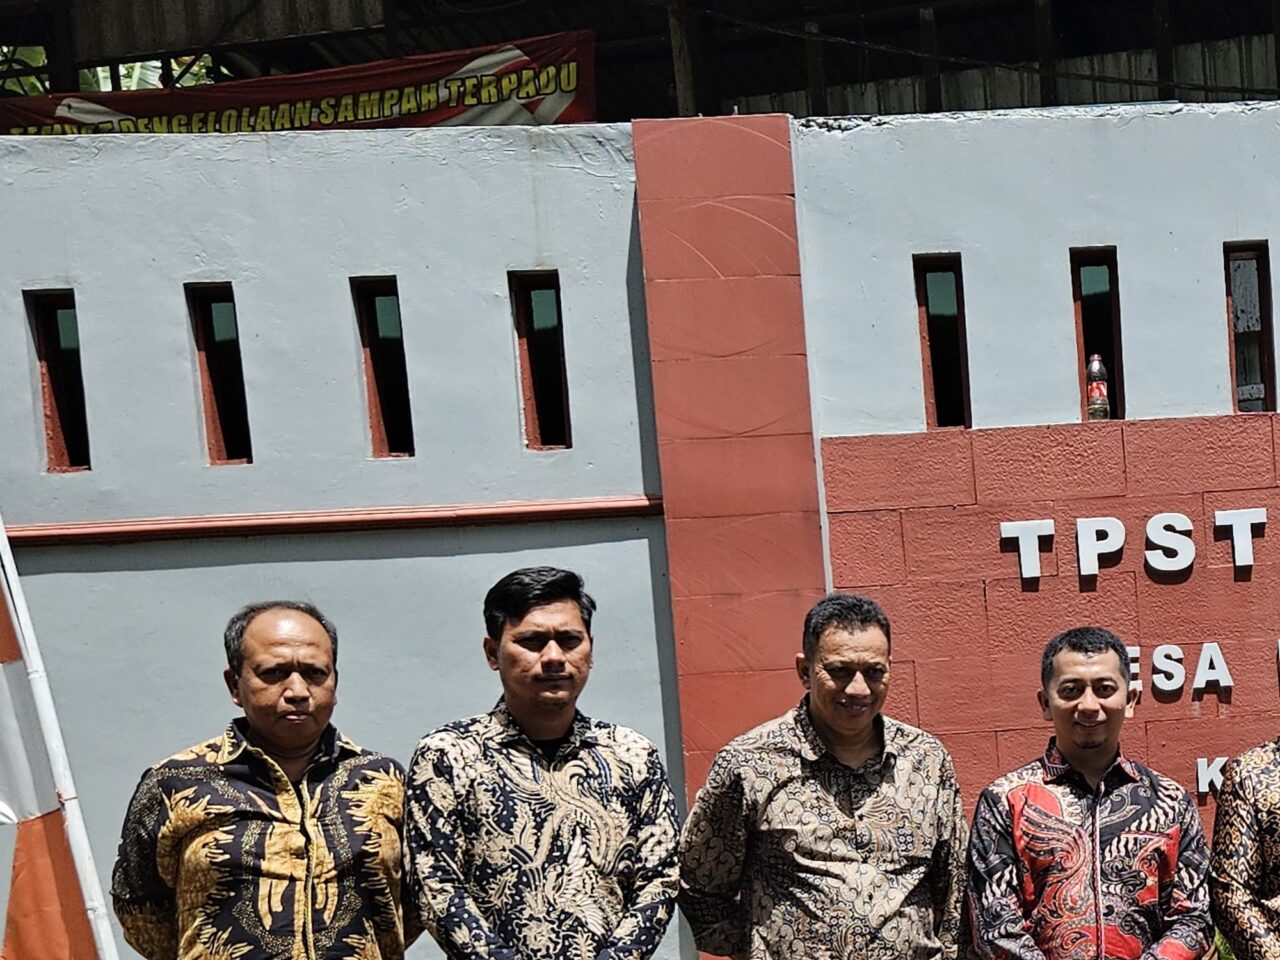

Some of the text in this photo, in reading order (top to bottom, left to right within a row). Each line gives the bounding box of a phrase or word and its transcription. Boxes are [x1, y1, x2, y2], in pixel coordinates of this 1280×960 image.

[319, 82, 438, 124] SAMPAH
[448, 61, 578, 107] TERPADU
[1000, 507, 1268, 578] TPST
